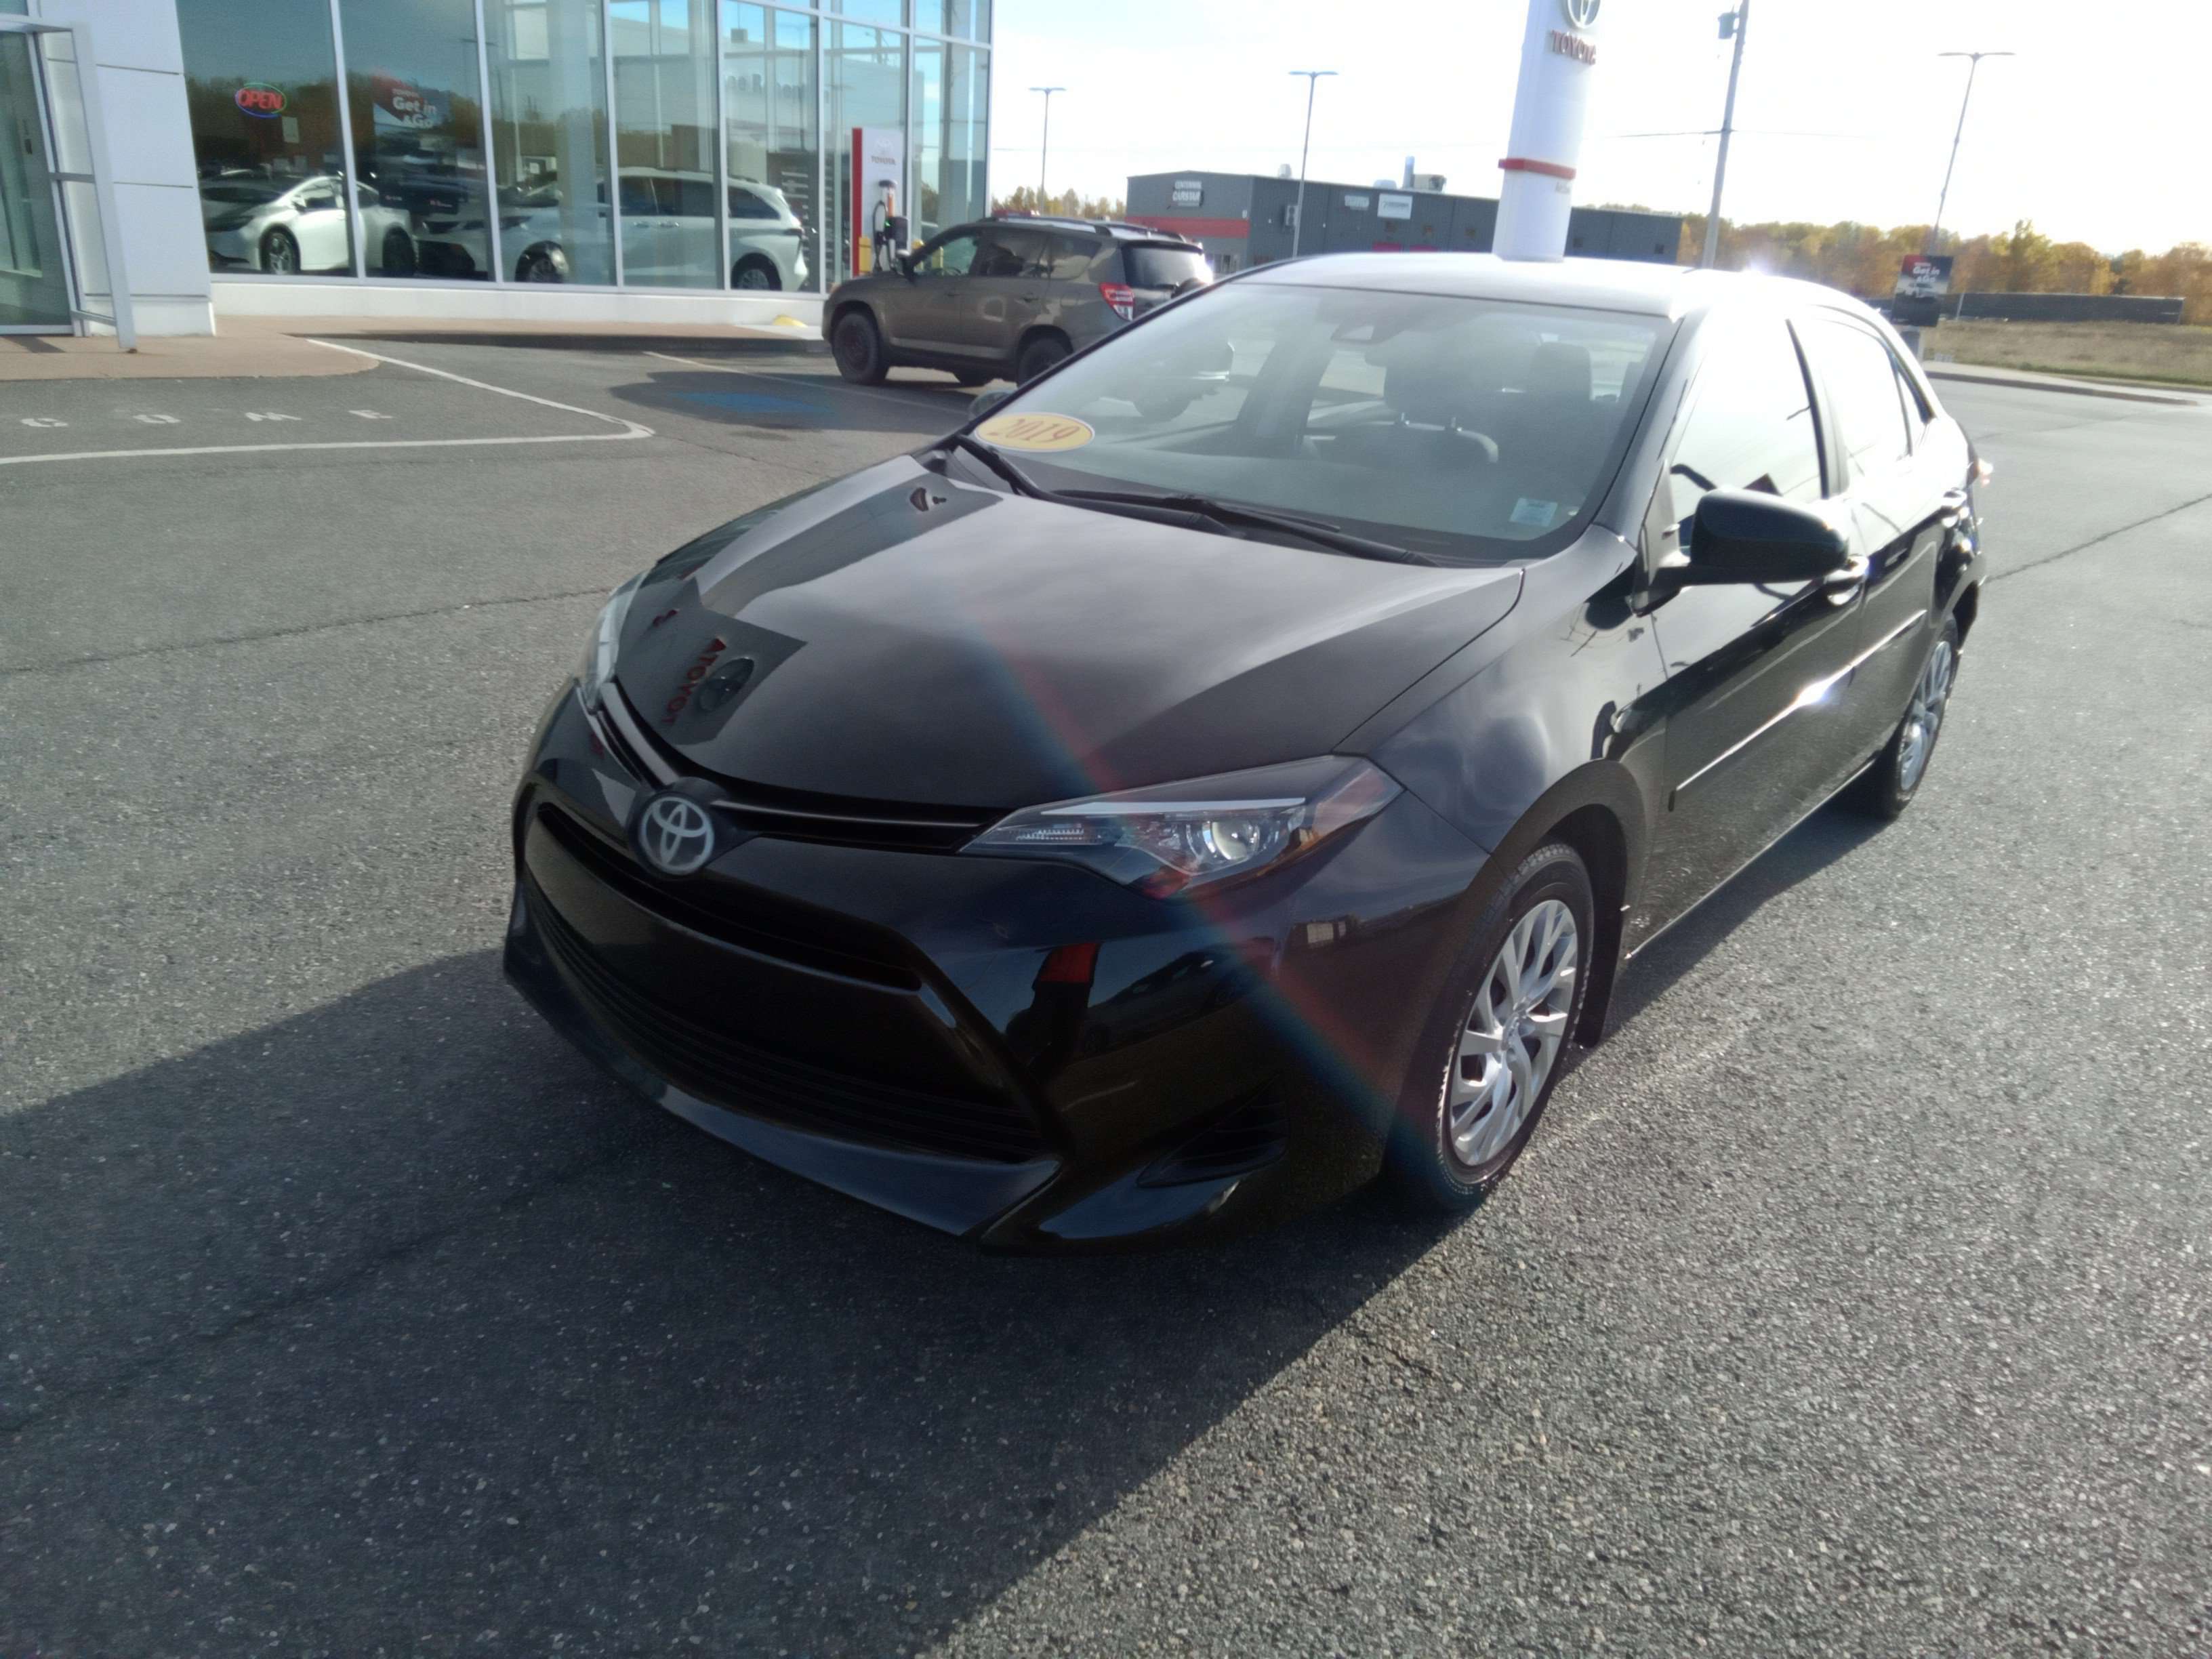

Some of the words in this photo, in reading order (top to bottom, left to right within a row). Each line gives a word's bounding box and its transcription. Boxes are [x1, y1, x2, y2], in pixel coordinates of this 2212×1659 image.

[1550, 29, 1596, 66] TOYOTA
[238, 89, 283, 110] OPEN
[393, 96, 421, 112] Get
[986, 418, 1080, 443] 2019
